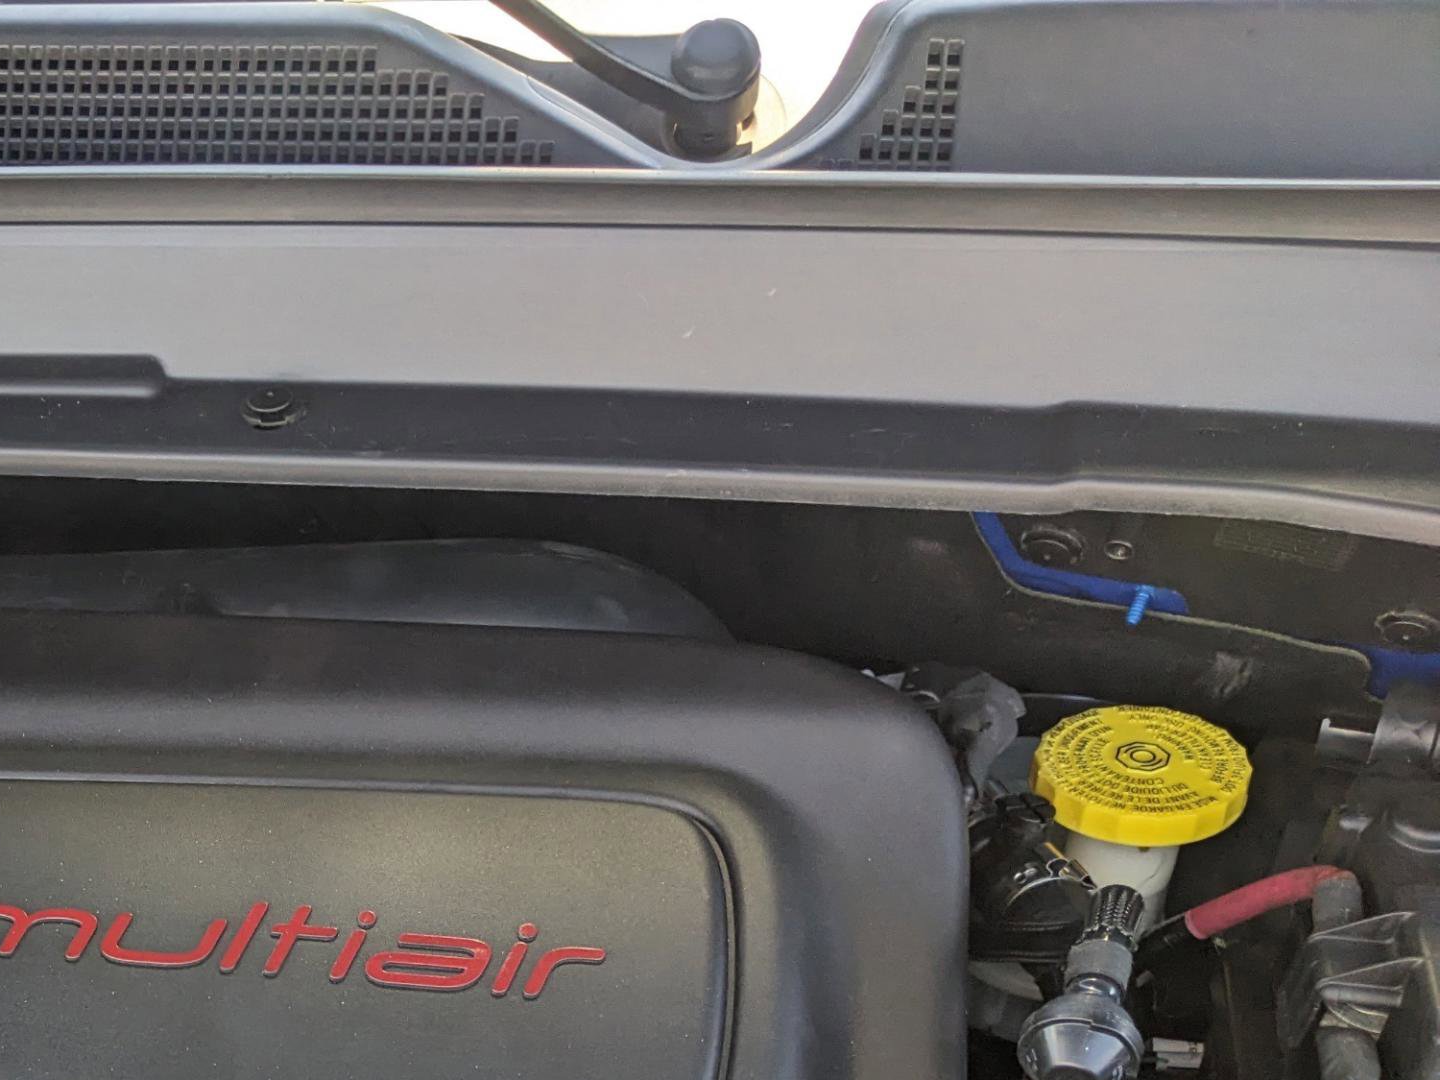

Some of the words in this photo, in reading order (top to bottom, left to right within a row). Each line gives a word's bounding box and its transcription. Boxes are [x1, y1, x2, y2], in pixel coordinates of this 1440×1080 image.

[1094, 764, 1164, 786] CONTENANT
[1210, 759, 1229, 783] BEFORE
[1096, 779, 1120, 790] DOT
[1171, 783, 1189, 792] DU
[1123, 786, 1172, 795] LIQUIDE
[1127, 795, 1142, 803] LE
[1165, 791, 1198, 804] AVANT
